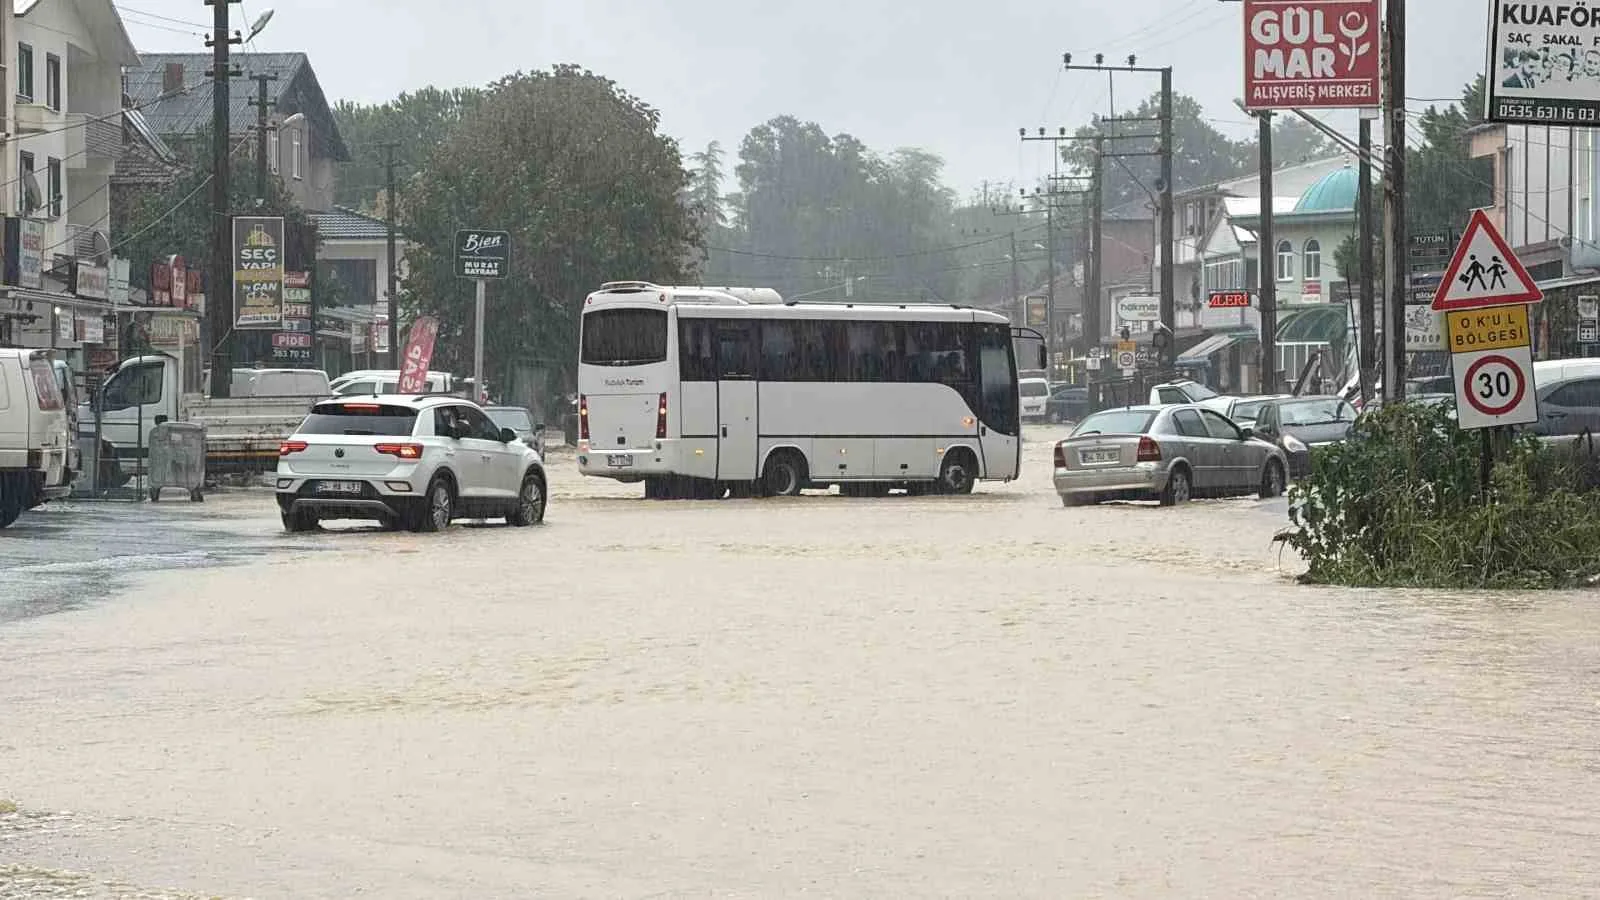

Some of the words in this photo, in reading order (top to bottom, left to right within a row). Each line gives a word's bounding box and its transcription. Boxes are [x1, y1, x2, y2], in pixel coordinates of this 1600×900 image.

[1251, 6, 1336, 45] GÜL
[1507, 33, 1532, 46] SAÇ
[1542, 34, 1582, 46] SAKAL
[1254, 47, 1336, 79] MAR
[1254, 83, 1316, 102] ALIŞVERİŞ
[1318, 82, 1372, 98] MERKEZİ
[1499, 105, 1532, 118] 0535
[1537, 106, 1558, 119] 631
[1562, 107, 1574, 120] 16
[1578, 108, 1595, 120] 03
[462, 234, 501, 251] Bien
[240, 248, 276, 260] SEÇ
[241, 262, 276, 270] YAPI
[464, 261, 499, 269] MURAT
[1461, 313, 1516, 328] OKUL
[278, 333, 305, 346] PİDE
[1478, 371, 1511, 399] 30
